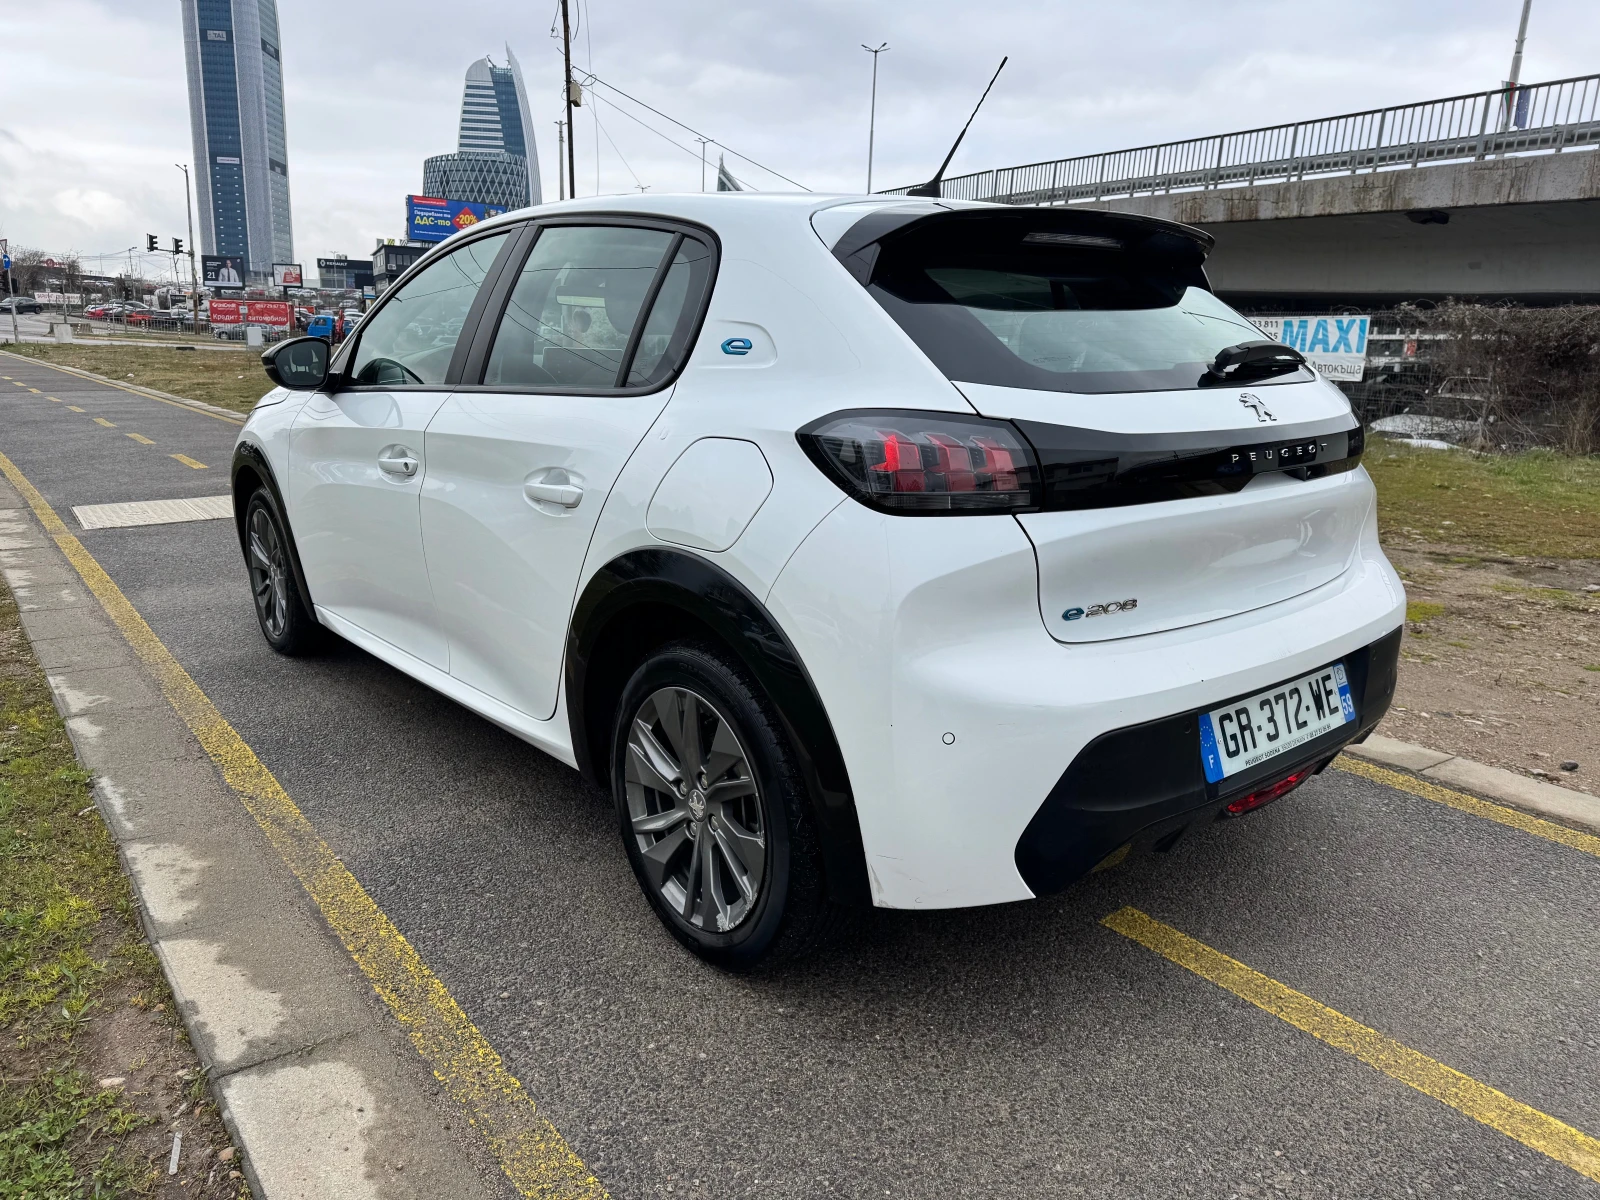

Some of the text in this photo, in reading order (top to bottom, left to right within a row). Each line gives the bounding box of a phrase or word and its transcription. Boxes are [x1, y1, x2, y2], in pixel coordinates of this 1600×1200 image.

[456, 214, 478, 225] -20%
[207, 271, 216, 279] 21
[212, 313, 238, 321] Кредит
[247, 314, 287, 323] автомобили
[1264, 320, 1279, 328] 811
[1281, 319, 1368, 353] MAXI
[1311, 361, 1362, 375] Автокъща
[1231, 443, 1328, 464] PEUGEOT
[1340, 693, 1354, 715] 59
[1208, 754, 1215, 769] F
